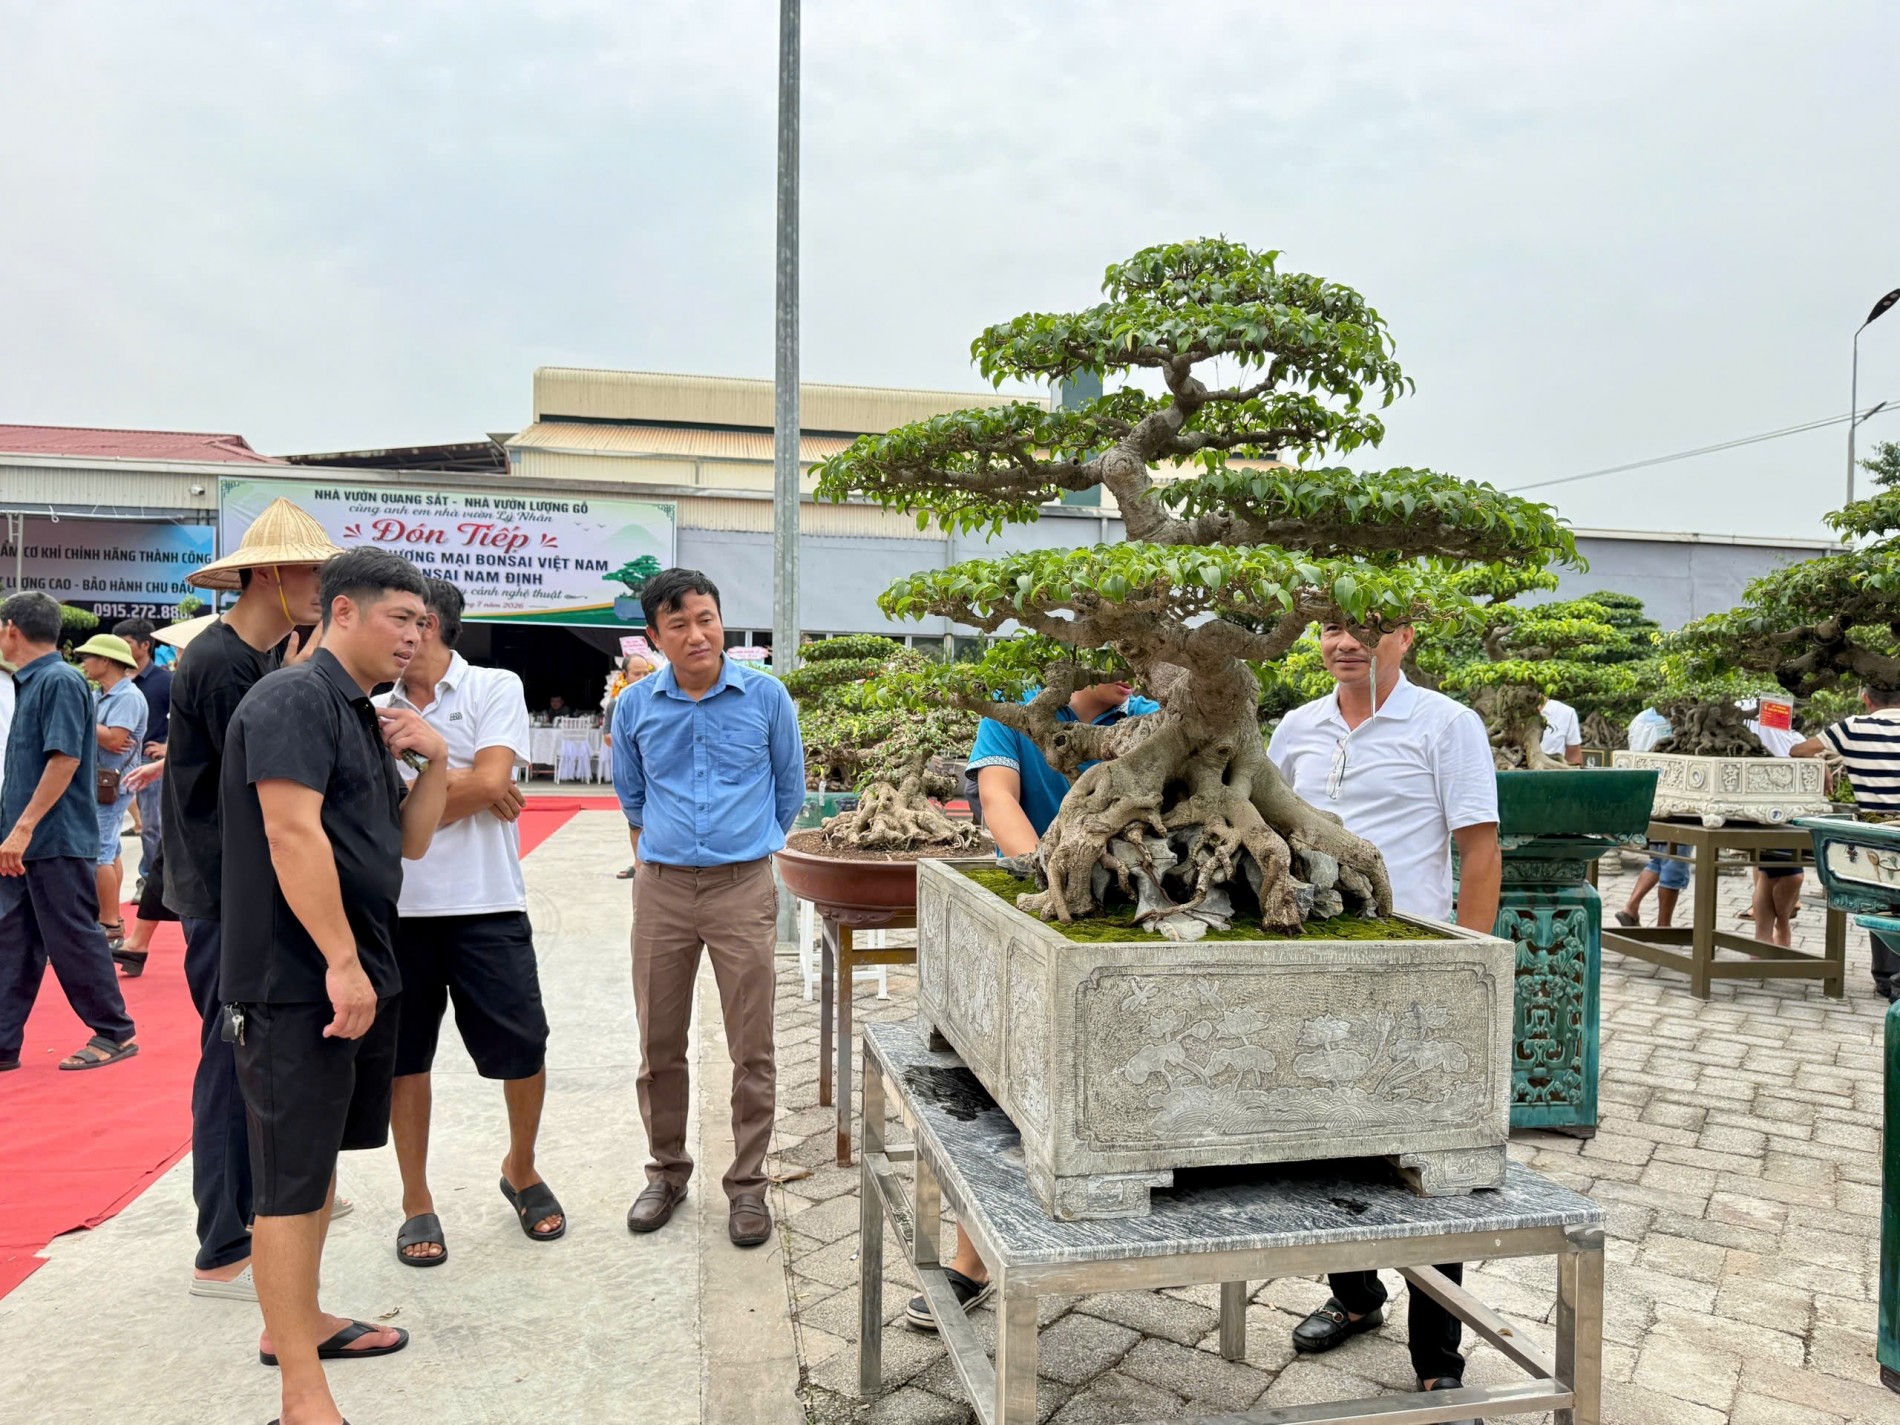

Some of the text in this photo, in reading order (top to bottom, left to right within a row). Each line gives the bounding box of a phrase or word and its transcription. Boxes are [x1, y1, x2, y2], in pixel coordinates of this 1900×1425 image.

[315, 489, 340, 500] NHÀ
[381, 493, 422, 505] QUANG
[465, 497, 489, 508] NHÀ
[530, 500, 569, 514] LƯỢNG
[384, 505, 409, 515] anh
[412, 508, 430, 516] em
[434, 507, 458, 518] nhà
[371, 518, 529, 554] Đón Tiếp
[23, 545, 38, 558] CƠ
[41, 544, 62, 558] KHÍ
[64, 545, 100, 560] CHÍNH
[103, 547, 136, 562] HÃNG
[139, 547, 178, 563] THÀNH
[182, 550, 212, 565] CÔNG
[441, 552, 470, 567] MẠI
[476, 554, 532, 568] BONSAI
[537, 555, 570, 572] VIỆT
[575, 558, 608, 571] NAM
[48, 578, 71, 590] CAO
[82, 575, 107, 591] BẢO
[110, 577, 142, 592] HÀNH
[146, 581, 168, 593] CHU
[422, 568, 543, 587] NSAI NAM ĐỊNH
